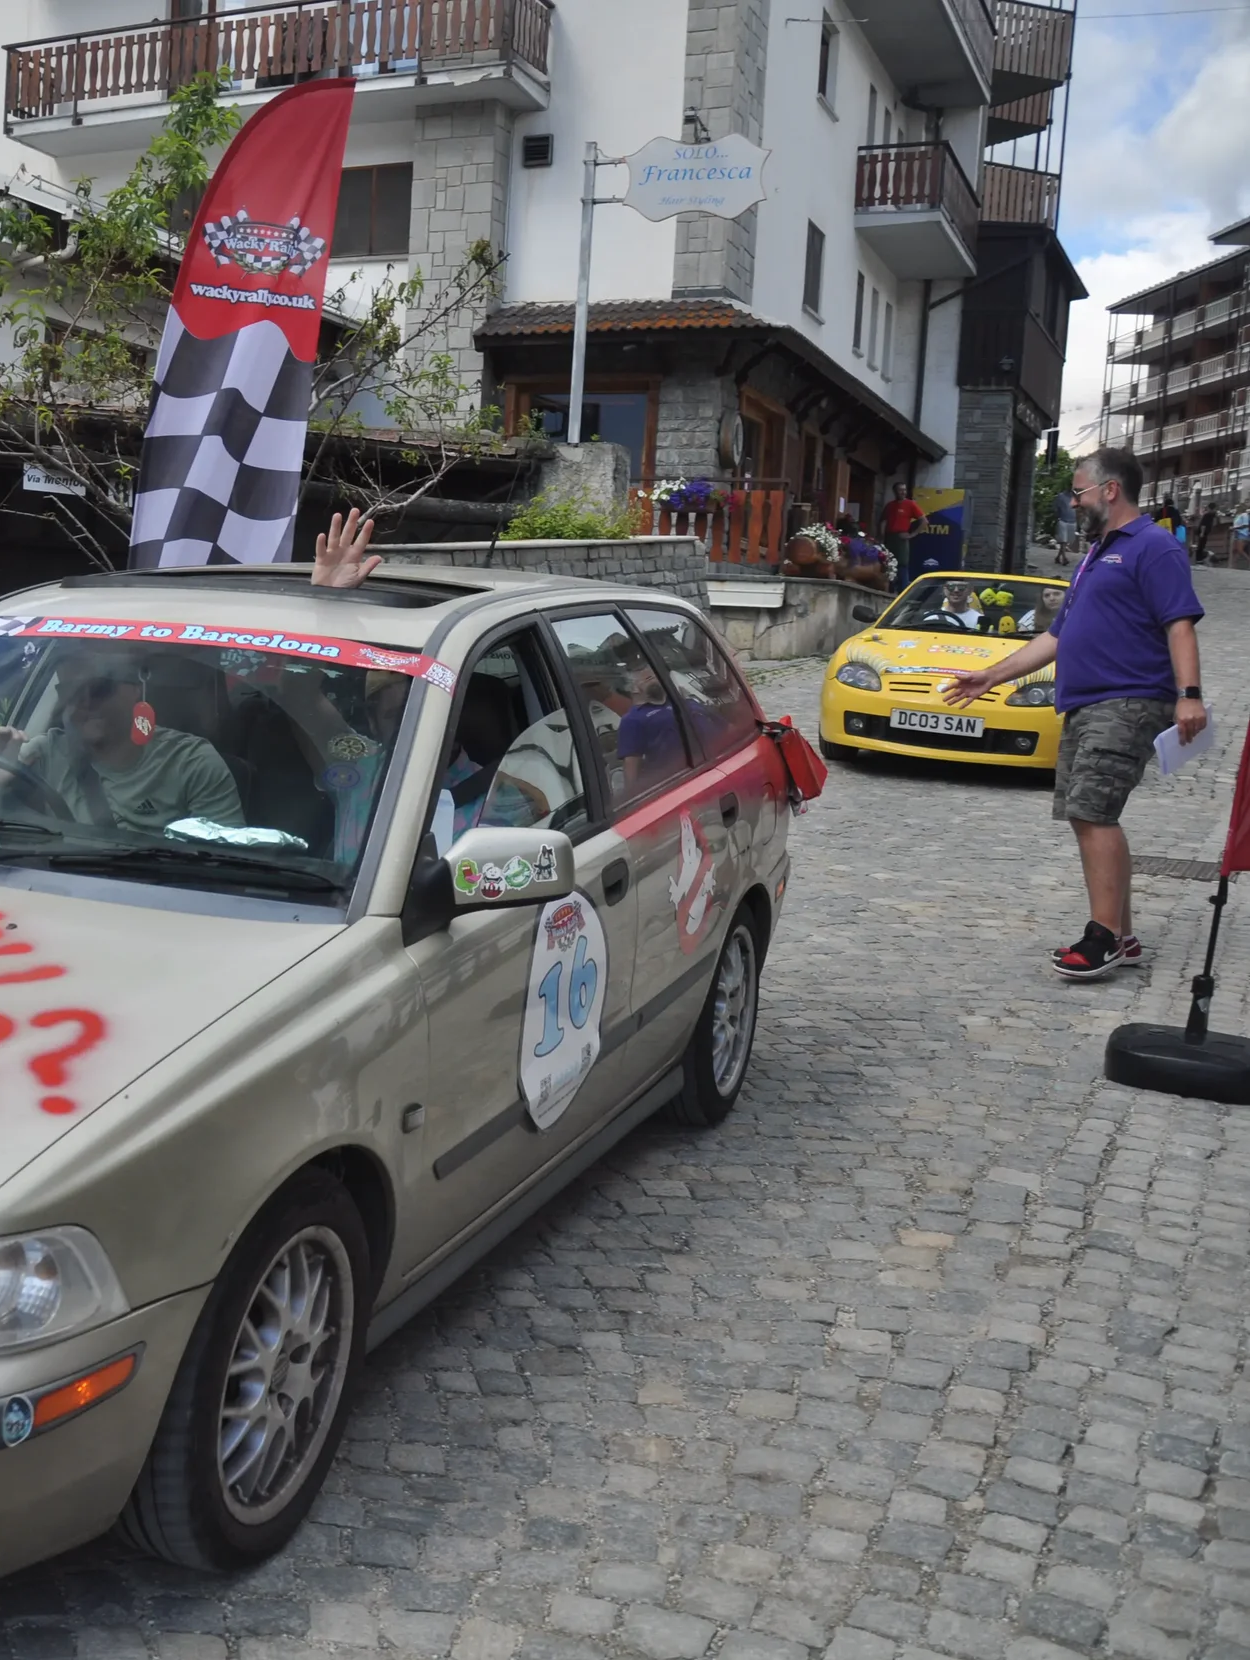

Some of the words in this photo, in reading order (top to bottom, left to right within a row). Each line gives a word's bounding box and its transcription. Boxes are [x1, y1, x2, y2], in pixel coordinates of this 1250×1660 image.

[673, 145, 729, 160] SOLO...
[639, 165, 752, 185] Francesca
[658, 196, 684, 205] Hair
[224, 237, 266, 252] Wacky
[269, 240, 300, 259] Rally
[27, 474, 41, 484] Via
[37, 619, 134, 637] Barmy
[139, 624, 172, 638] to
[177, 625, 341, 658] Barcelona
[897, 711, 939, 729] DC03
[944, 717, 977, 734] SAN
[534, 935, 598, 1058] 16
